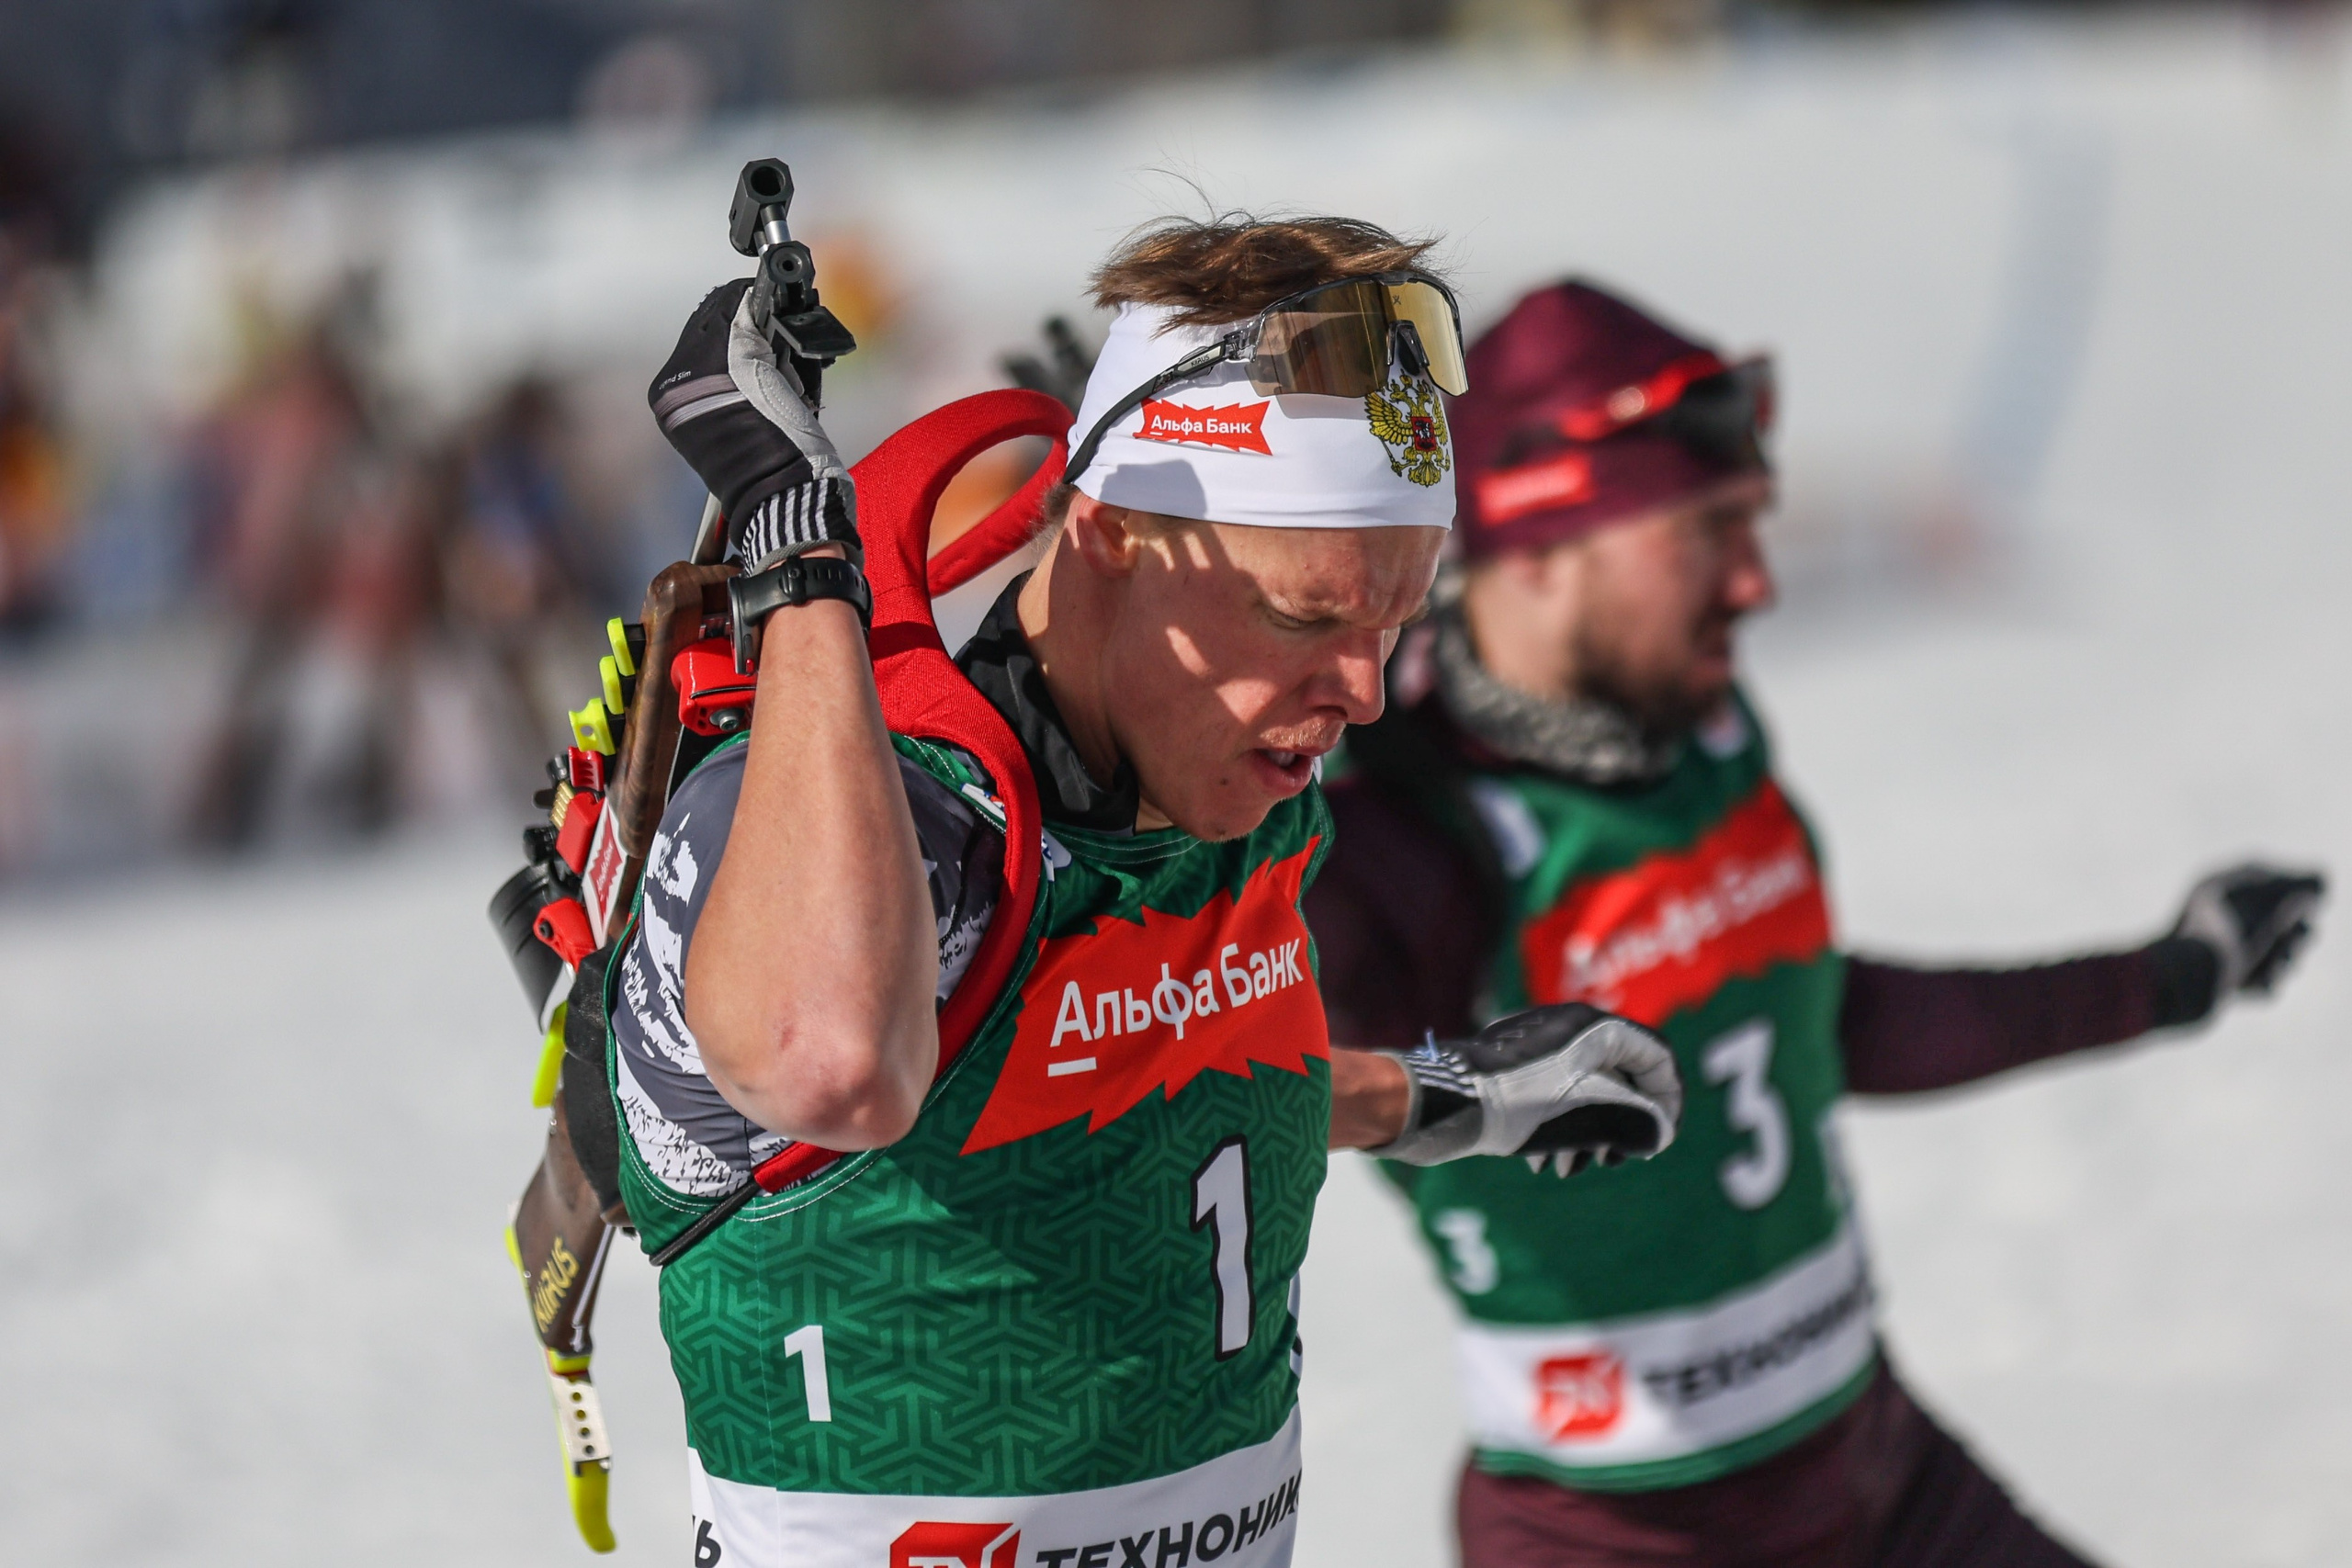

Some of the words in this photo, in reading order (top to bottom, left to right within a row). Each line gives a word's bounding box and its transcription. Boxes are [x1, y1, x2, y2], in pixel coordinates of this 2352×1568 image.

[1149, 414, 1204, 435] Альфа
[1206, 418, 1252, 434] Банк
[1048, 963, 1220, 1049] Альфа
[1220, 938, 1304, 1009] Банк
[1703, 1017, 1791, 1210] 3
[1192, 1134, 1254, 1360] 1
[1434, 1208, 1498, 1294] 3
[784, 1325, 831, 1422] 1
